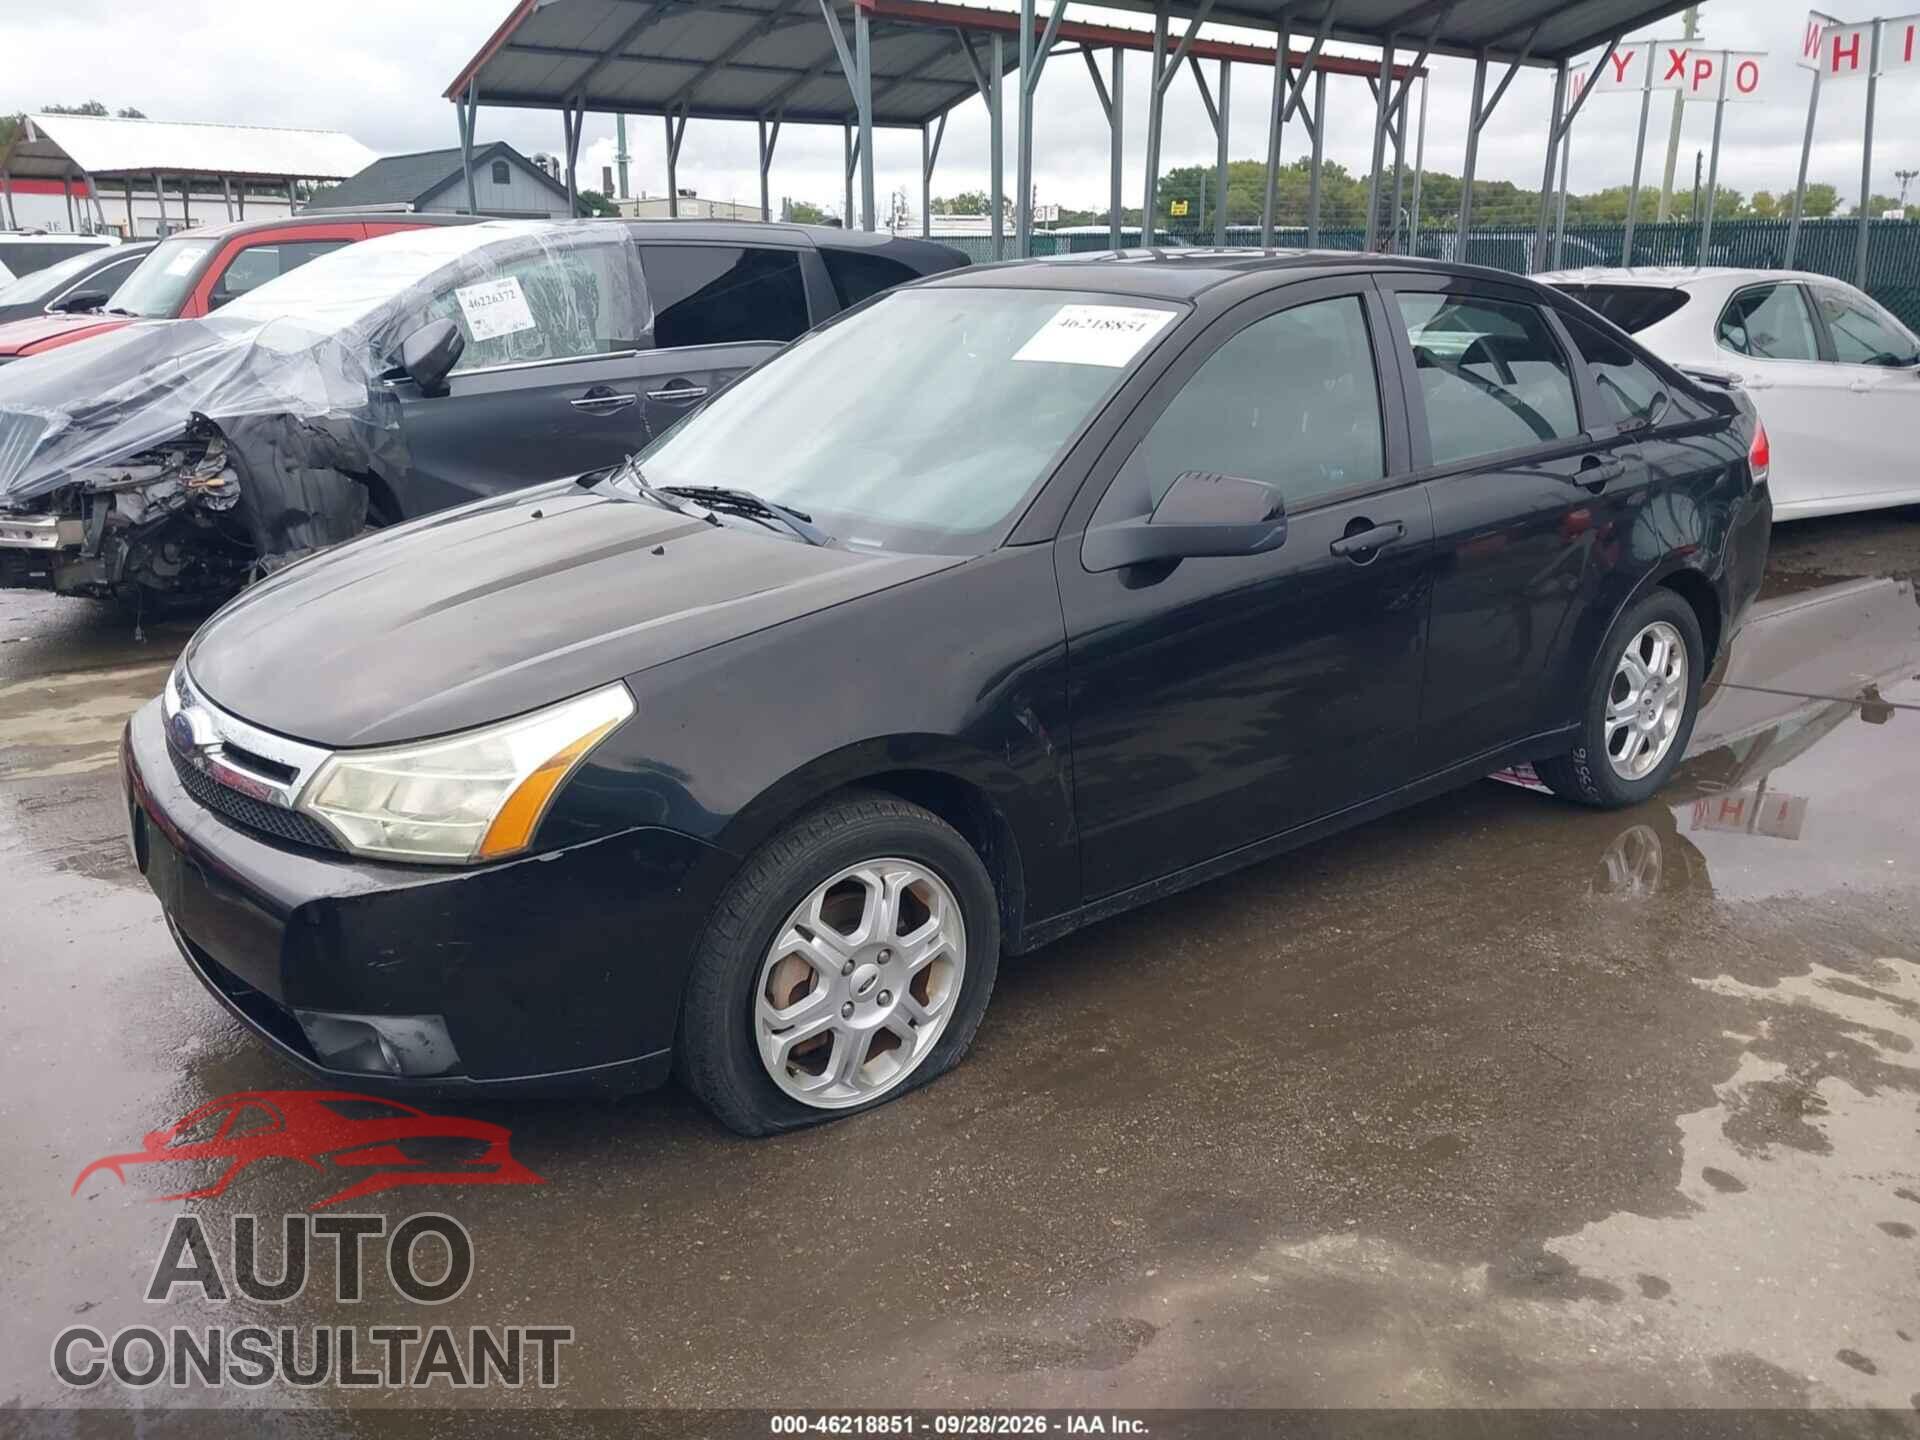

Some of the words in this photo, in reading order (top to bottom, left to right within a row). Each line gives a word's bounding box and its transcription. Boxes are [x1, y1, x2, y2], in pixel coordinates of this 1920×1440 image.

[1610, 50, 1635, 83] Y
[1664, 48, 1692, 80] X
[1832, 33, 1860, 72] H
[1903, 25, 1915, 62] I
[1692, 59, 1713, 91] P
[1736, 61, 1759, 93] O
